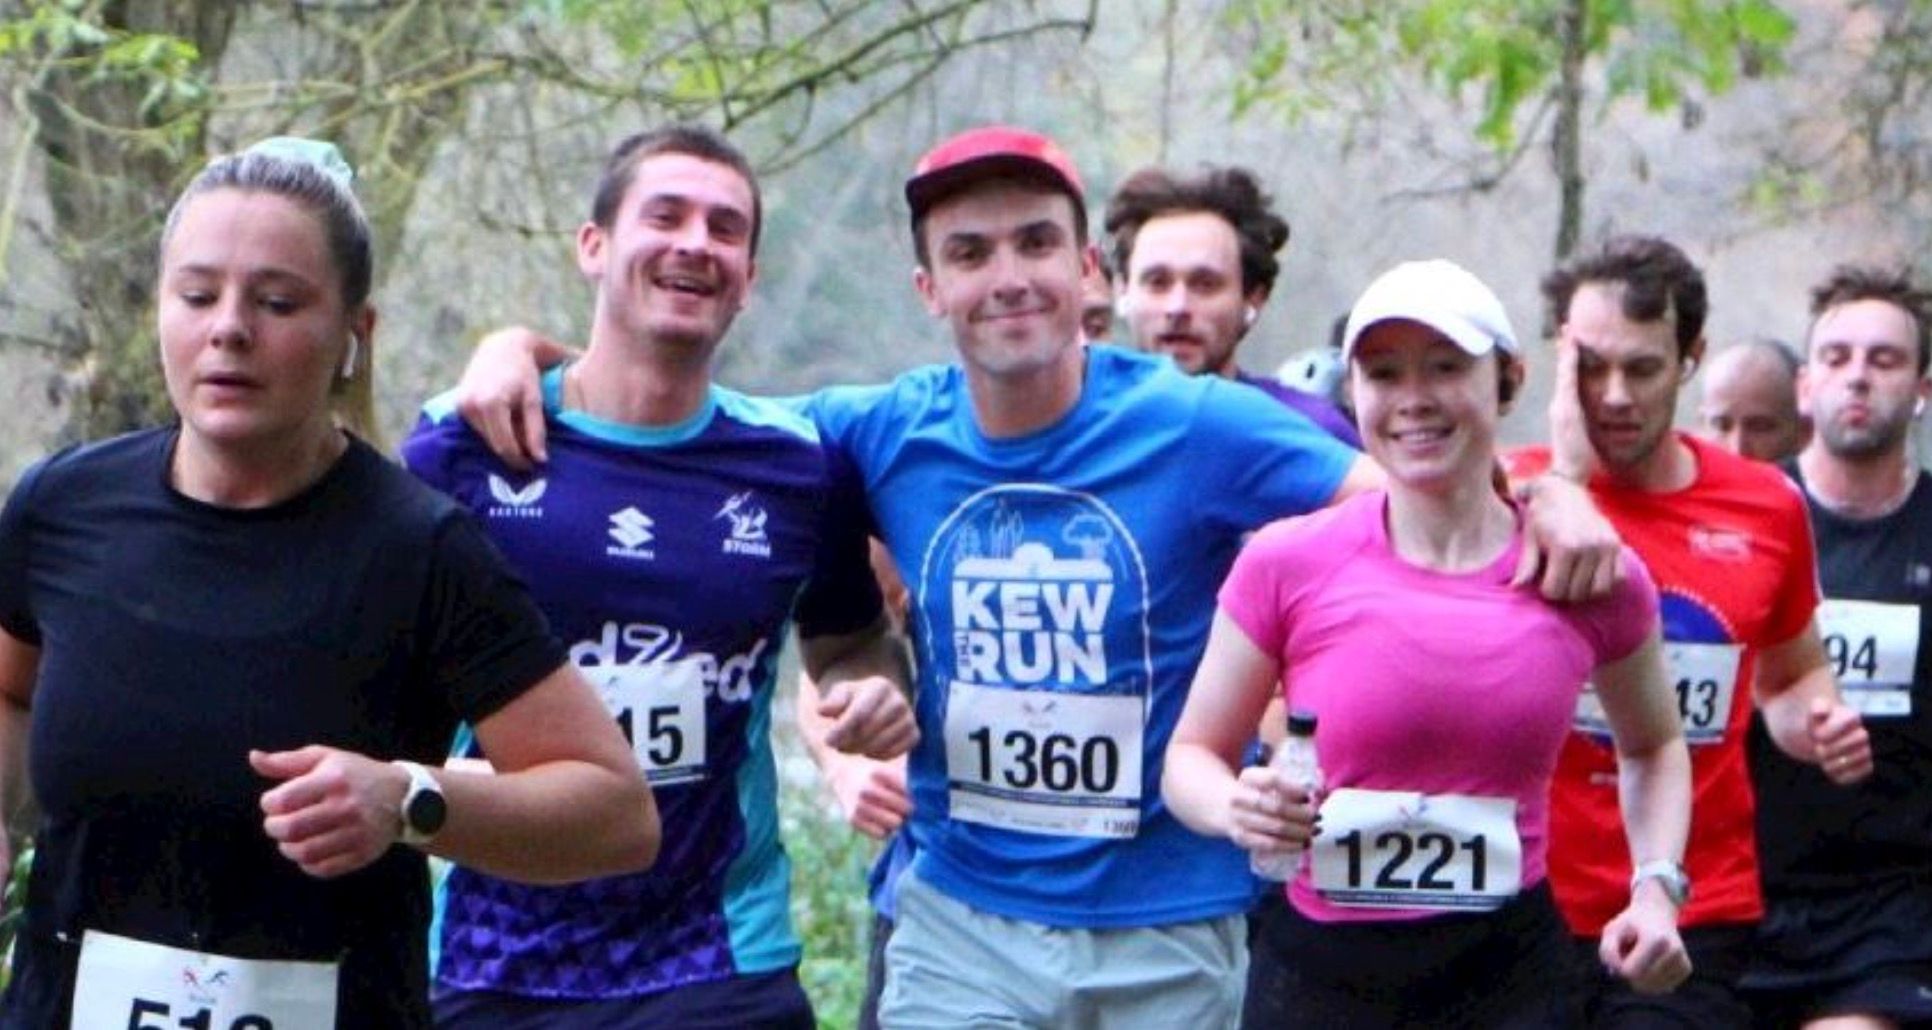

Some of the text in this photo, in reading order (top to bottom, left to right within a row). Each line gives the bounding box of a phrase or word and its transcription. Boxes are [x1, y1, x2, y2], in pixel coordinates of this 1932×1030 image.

[952, 580, 1114, 633] KEW
[954, 630, 1108, 685] RUN
[1823, 634, 1878, 681] 94
[968, 726, 1119, 794] 1360
[1335, 829, 1487, 891] 1221
